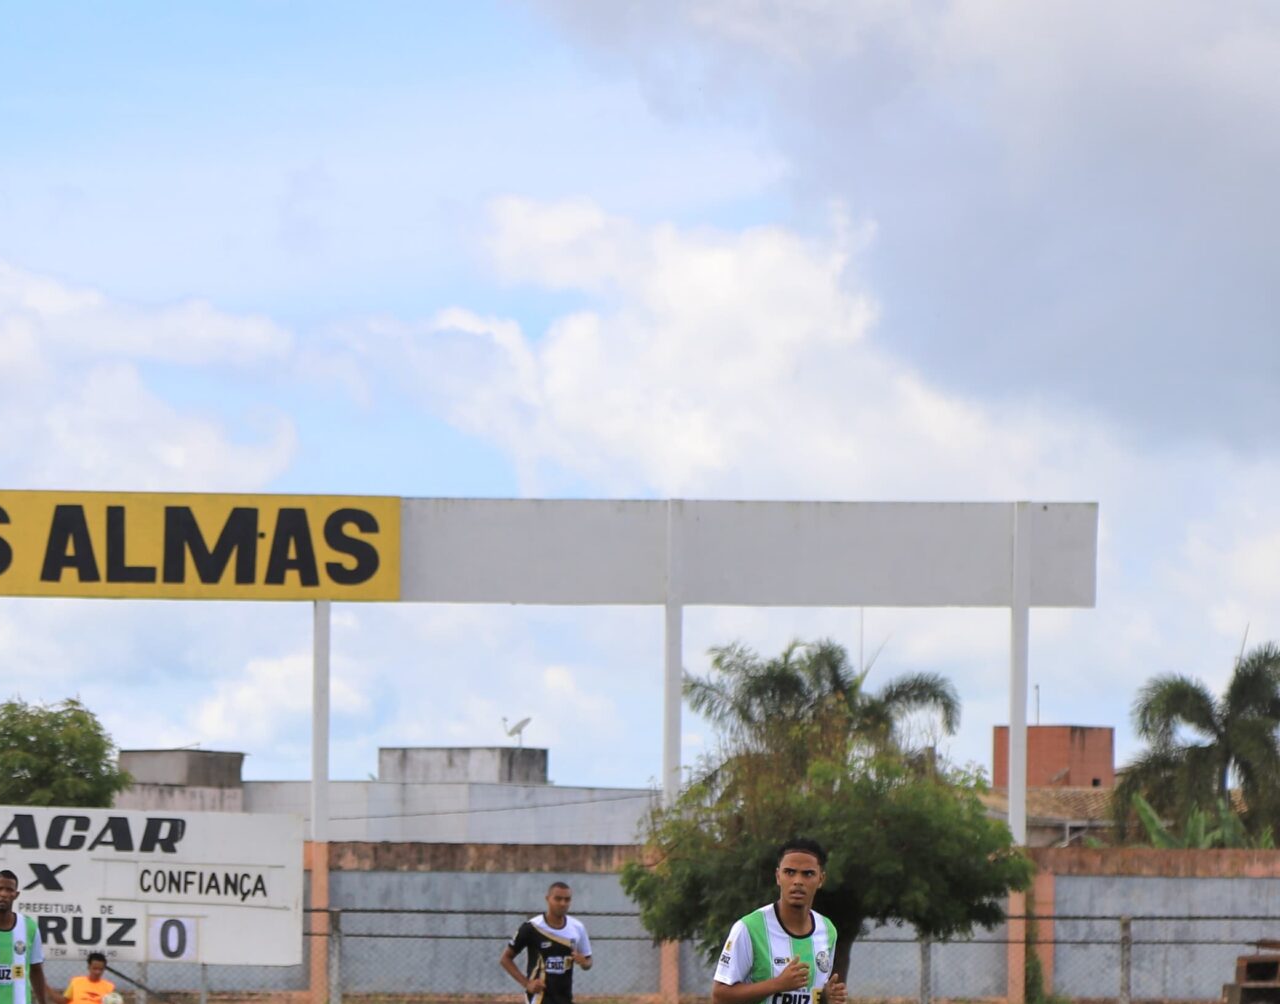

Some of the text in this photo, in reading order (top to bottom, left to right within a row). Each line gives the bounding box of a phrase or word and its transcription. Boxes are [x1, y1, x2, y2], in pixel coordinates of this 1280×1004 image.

[39, 504, 380, 588] ALMAS
[22, 863, 71, 892] X
[139, 869, 267, 901] CONFIANÇA
[18, 902, 114, 915] PREFEITURA DE
[37, 915, 137, 946] RUZ
[160, 918, 187, 959] 0
[49, 948, 67, 957] TEM
